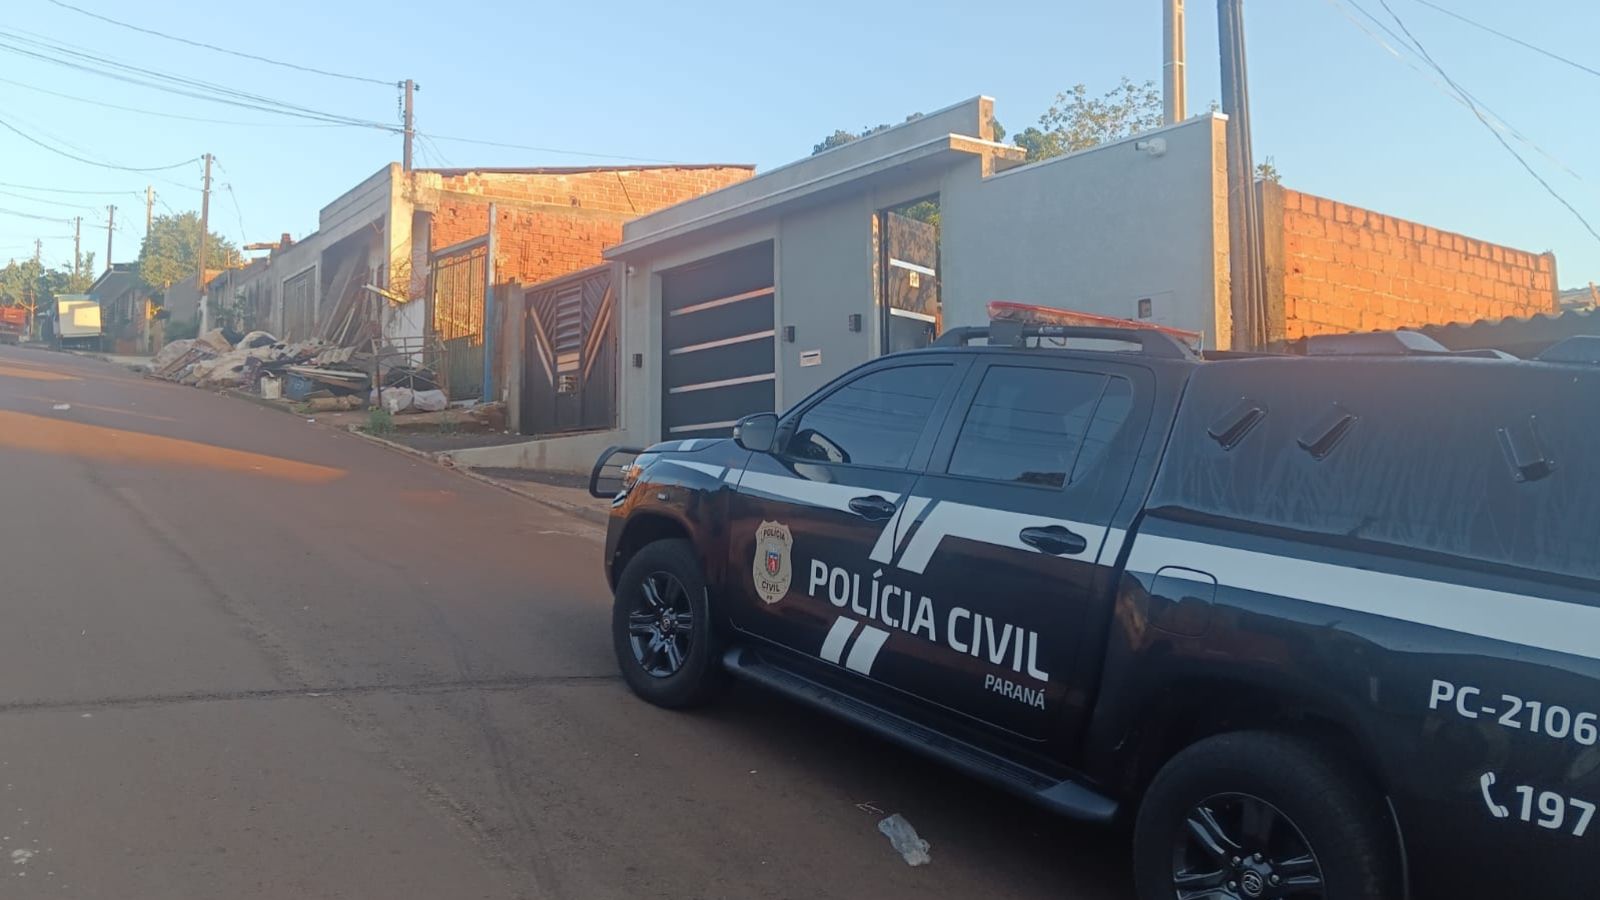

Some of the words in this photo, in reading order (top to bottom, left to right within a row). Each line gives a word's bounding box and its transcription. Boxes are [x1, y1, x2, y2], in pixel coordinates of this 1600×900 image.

[761, 580, 781, 592] CIVIL
[809, 559, 936, 641] POLÍCIA
[947, 607, 1048, 681] CIVIL
[985, 674, 1045, 709] PARANÁ
[1429, 679, 1600, 745] PC-2106
[1516, 785, 1596, 836] 197
